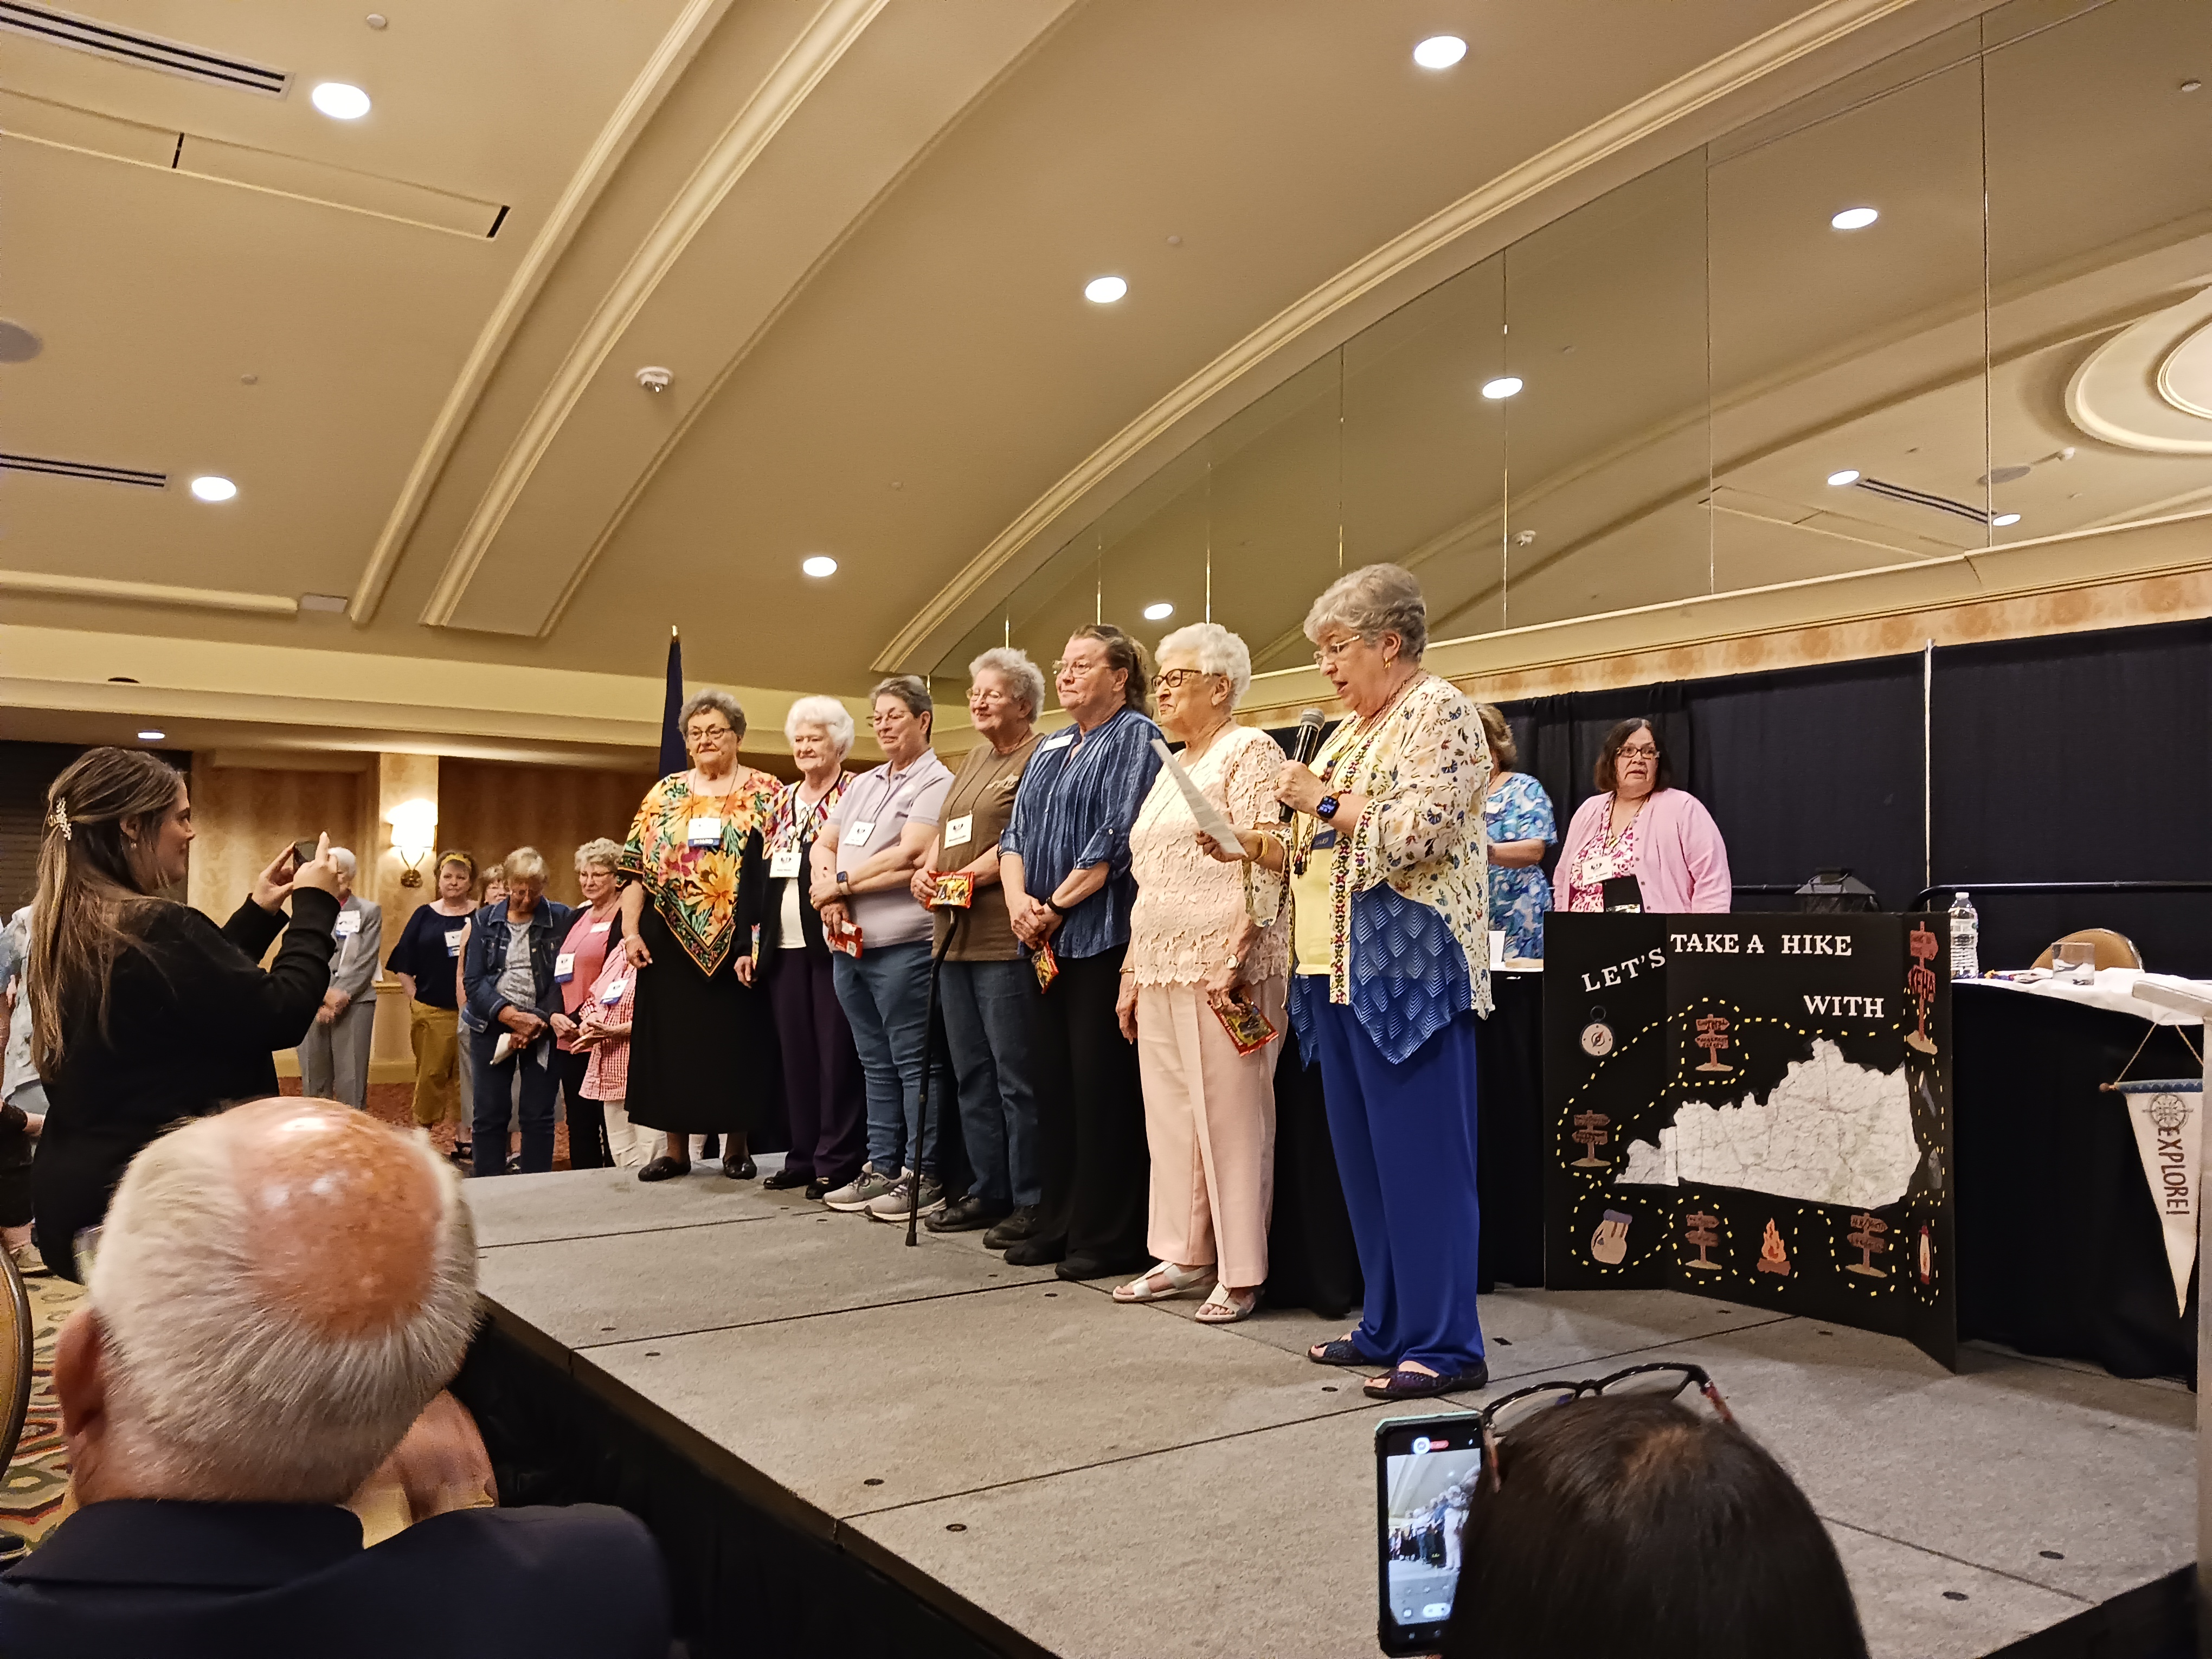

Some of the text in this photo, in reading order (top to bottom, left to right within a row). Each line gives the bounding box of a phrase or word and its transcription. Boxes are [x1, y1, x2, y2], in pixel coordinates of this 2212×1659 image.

[1581, 933, 1852, 992] LET'S TAKE A HIKE
[1803, 995, 1885, 1018] WITH
